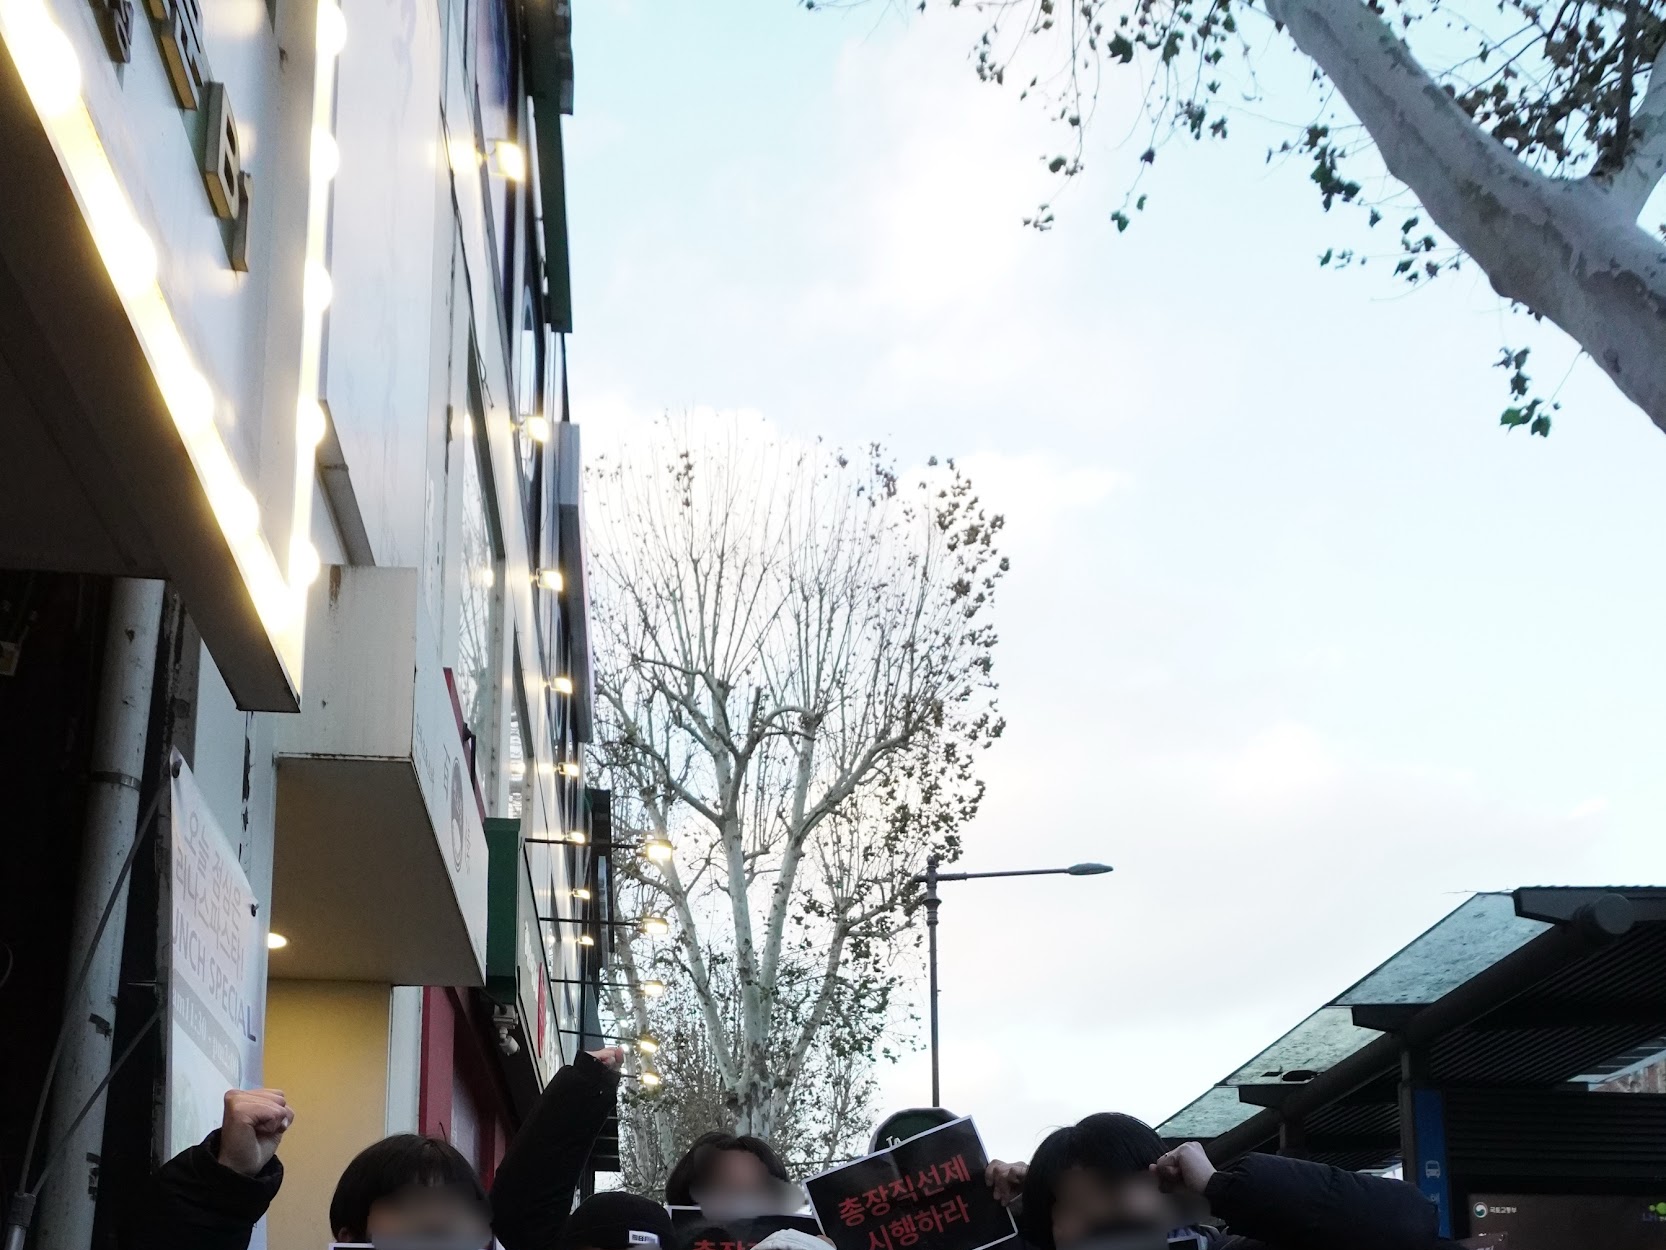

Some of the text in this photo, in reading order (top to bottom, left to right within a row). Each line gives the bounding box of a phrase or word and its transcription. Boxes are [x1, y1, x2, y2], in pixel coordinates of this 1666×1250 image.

[184, 810, 241, 932] 오늘 점심은
[172, 907, 257, 1043] UNCH SPECIAL
[837, 1153, 972, 1228] 총장직선제
